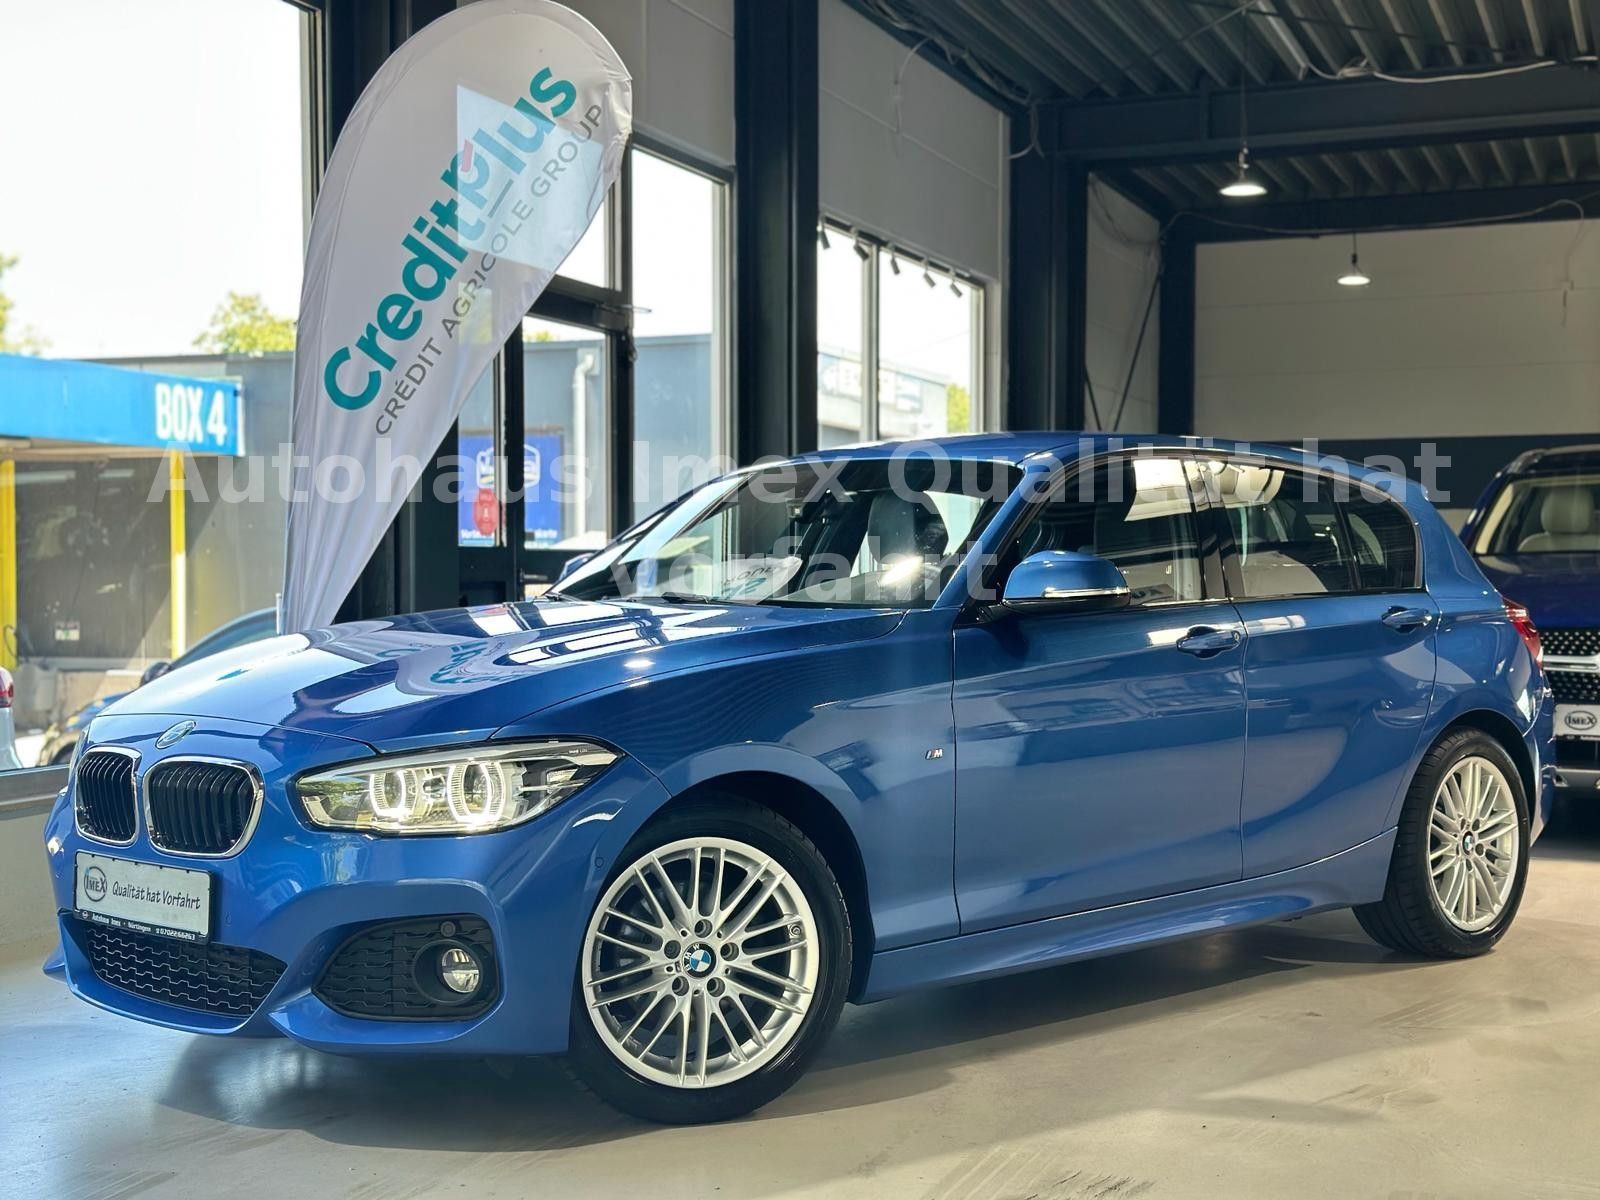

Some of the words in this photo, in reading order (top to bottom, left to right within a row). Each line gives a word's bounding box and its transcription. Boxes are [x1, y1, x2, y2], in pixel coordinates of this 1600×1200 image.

[324, 67, 577, 411] Creditplus
[375, 336, 443, 435] CRÉDIT
[440, 199, 534, 339] AGRICOLE
[531, 104, 602, 198] GROUP
[155, 382, 204, 444] BOX
[206, 389, 228, 447] 4
[112, 880, 145, 900] Qualität
[146, 887, 161, 904] hat
[162, 889, 201, 910] Vorfahrt
